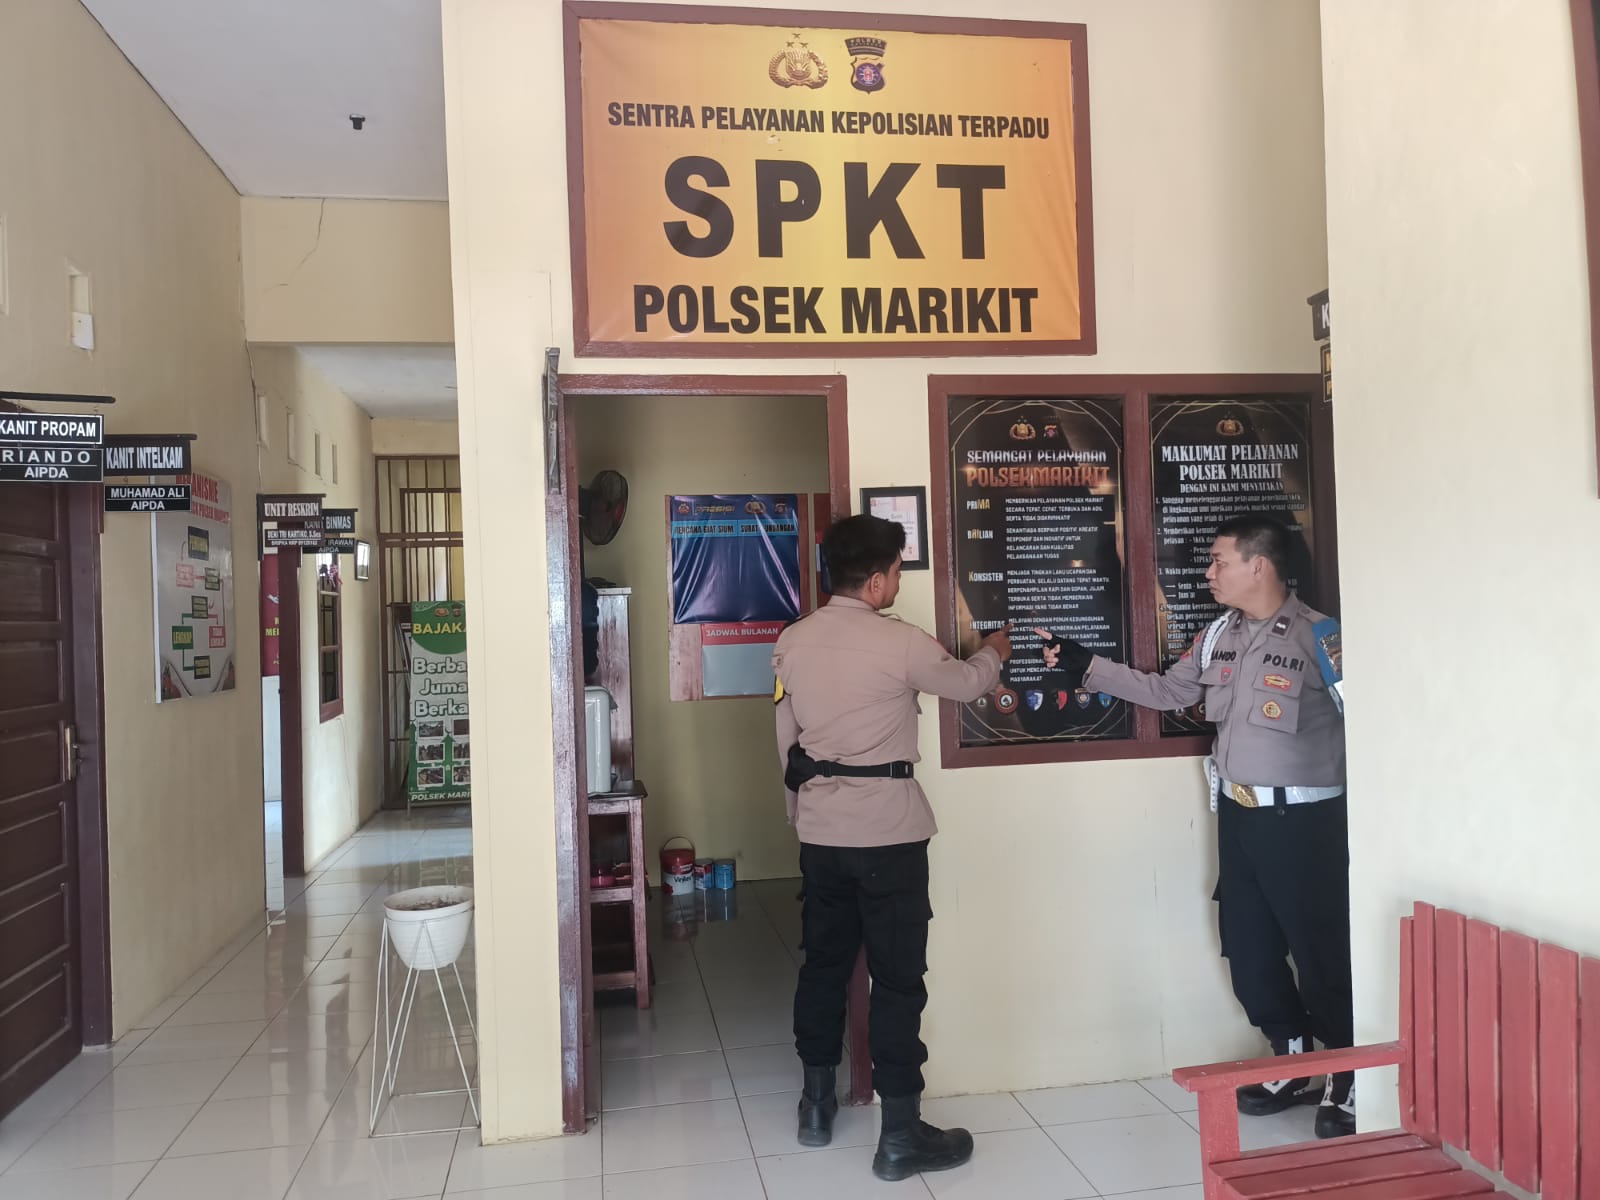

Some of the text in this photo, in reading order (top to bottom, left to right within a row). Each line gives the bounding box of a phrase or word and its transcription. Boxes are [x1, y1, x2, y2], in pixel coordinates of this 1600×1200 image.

[608, 102, 1049, 139] SENTRA PELAYANAN KEPOLISIAN TERPADU
[662, 155, 1006, 260] SPKT
[633, 284, 1038, 335] POLSEK MARIKIT
[41, 421, 96, 437] PROPAM
[2, 450, 91, 464] RIANDO
[106, 446, 183, 470] KANIT INTELKAM
[967, 450, 1107, 463] SEMANGAT PELAYANAN
[1162, 444, 1299, 462] MAKLUMAT PELAYANAN
[24, 466, 69, 478] AIPDA
[1179, 463, 1284, 480] POLSEK MARIKIT
[110, 486, 185, 499] MUHAMAD ALI
[1180, 484, 1208, 494] DENGAN
[1209, 483, 1220, 492] INI
[1221, 482, 1240, 492] KAMI
[130, 500, 165, 511] AIPDA
[264, 502, 319, 517] UNIT RESKRIM
[325, 515, 352, 530] BINMAS
[968, 571, 1004, 582] KONSISTEN
[706, 628, 778, 637] JADWAL BULANAN
[1262, 653, 1304, 672] POLRI
[411, 792, 446, 801] POLSEK
